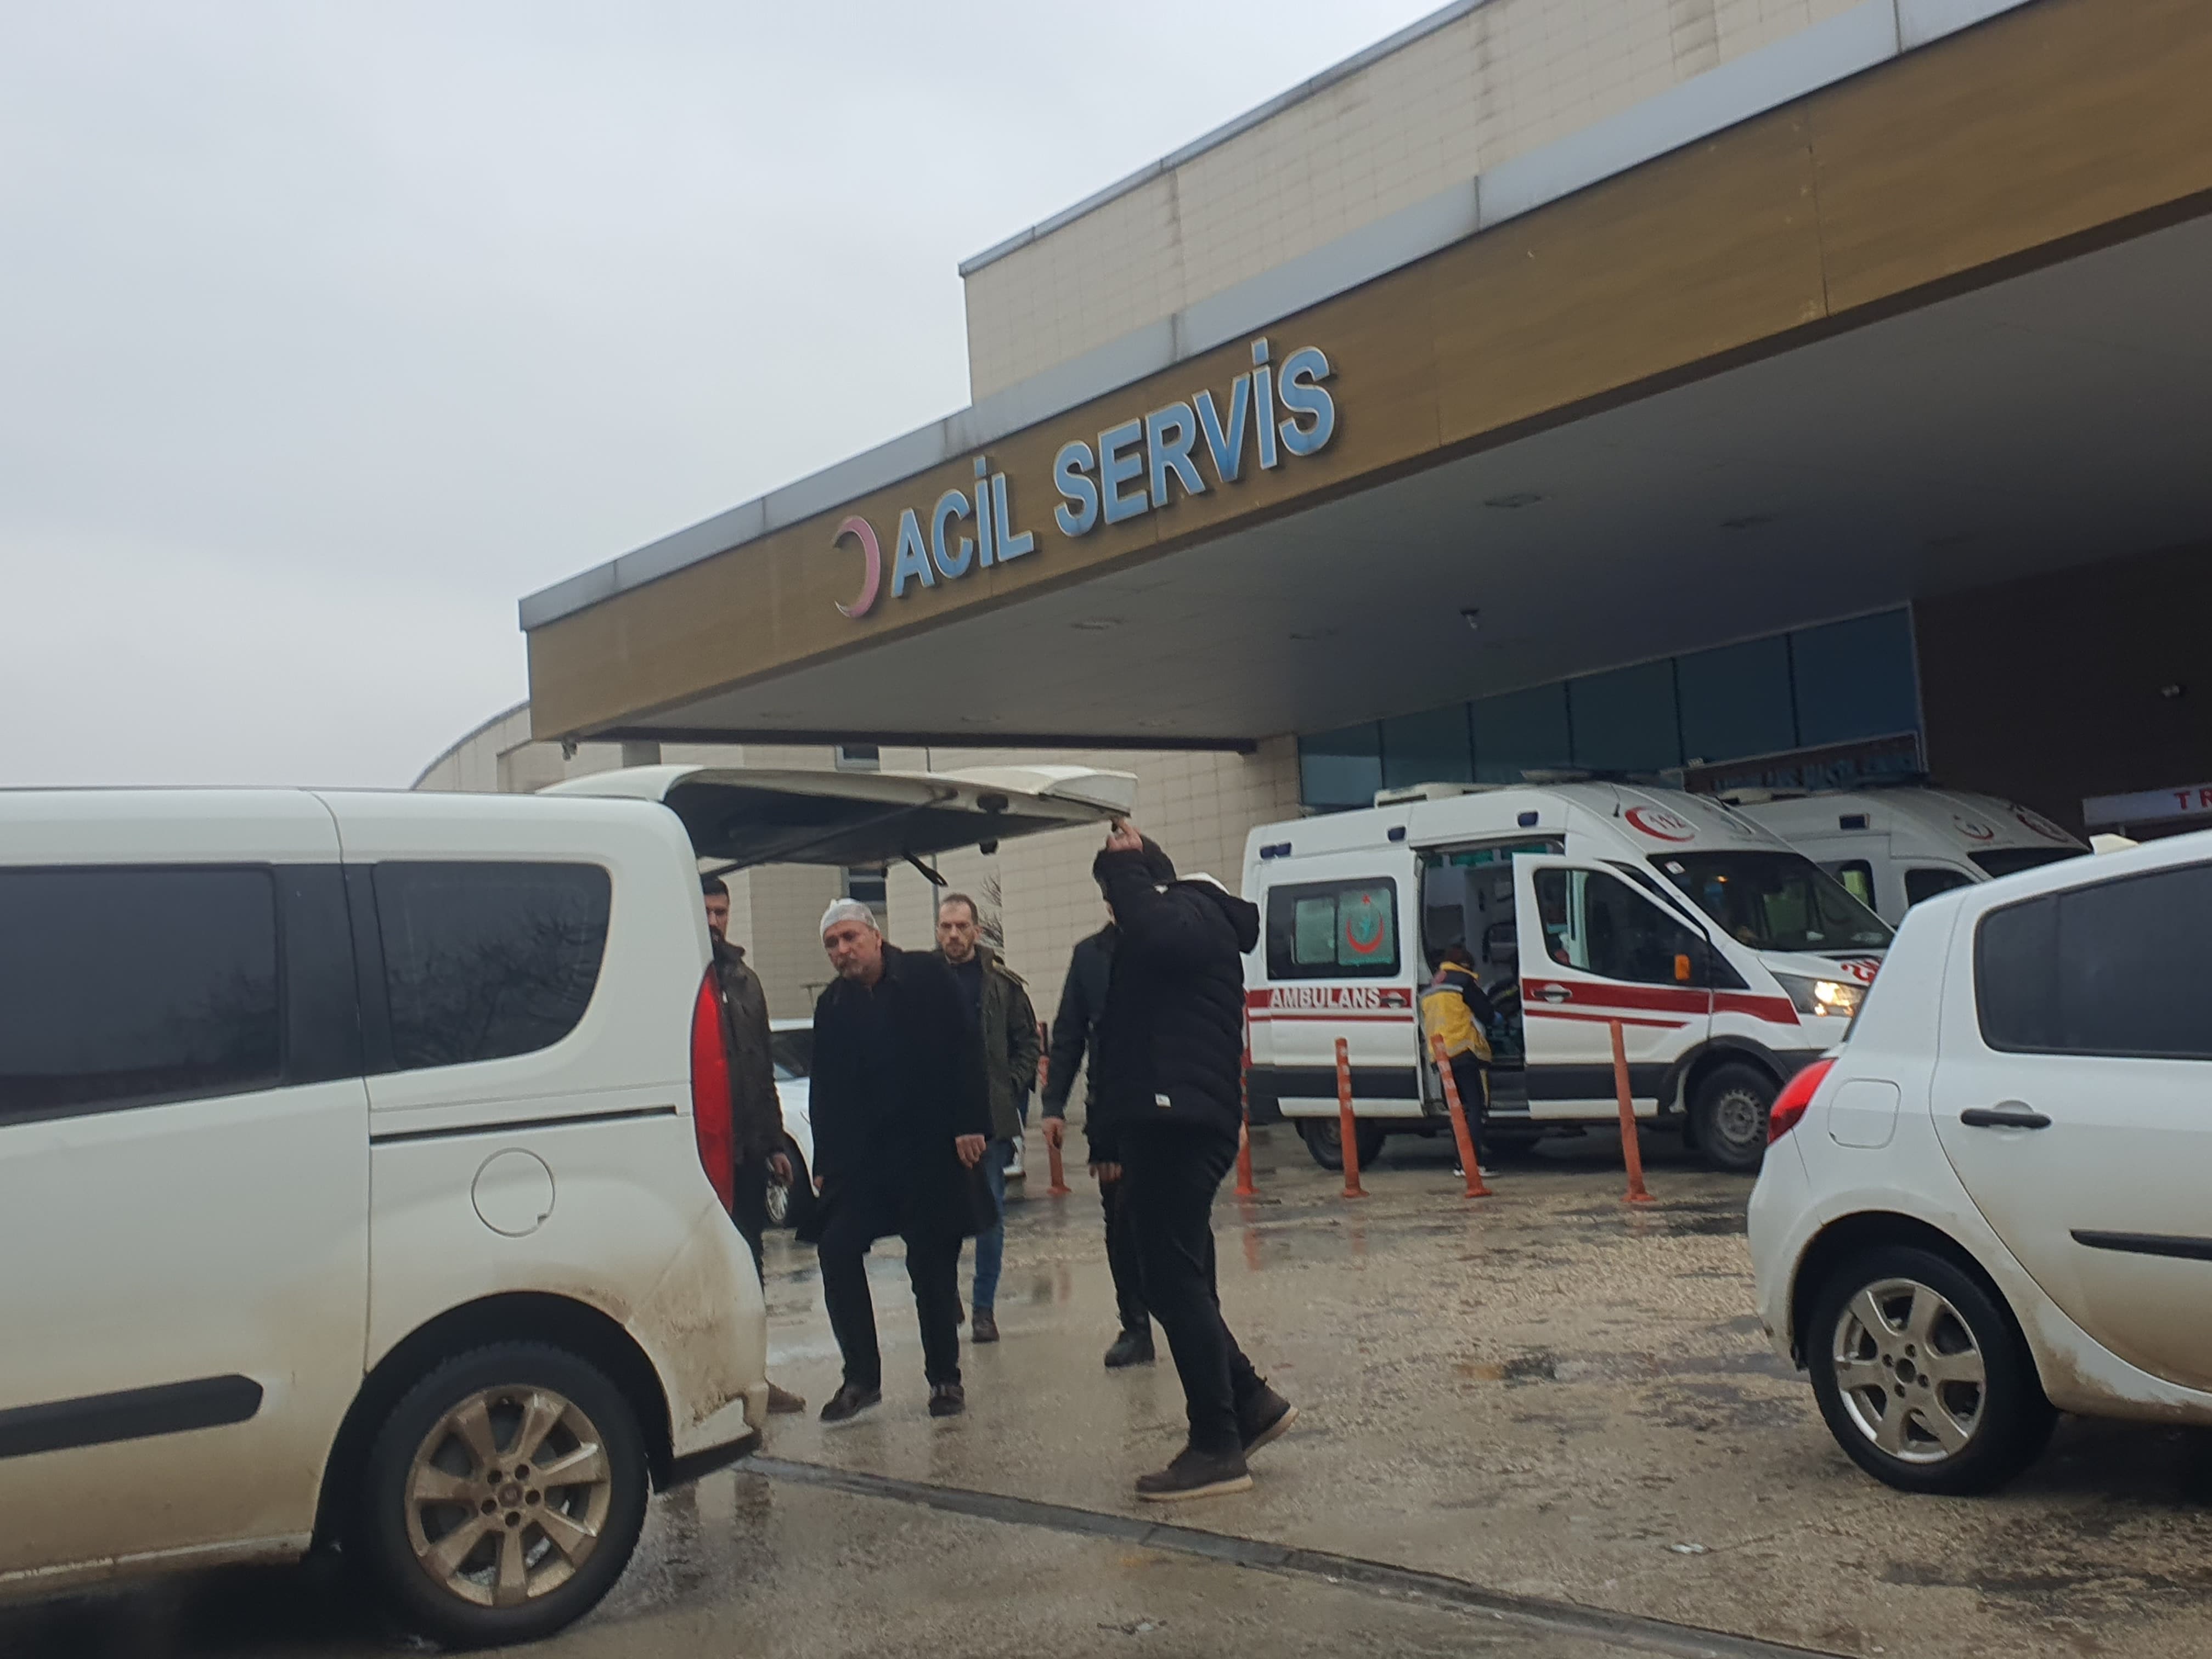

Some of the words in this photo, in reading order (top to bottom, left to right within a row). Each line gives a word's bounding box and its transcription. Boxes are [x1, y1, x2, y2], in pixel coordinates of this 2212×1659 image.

[890, 455, 1034, 597] ACİL
[1053, 337, 1335, 537] SERVİS
[1648, 813, 1686, 830] 112
[1271, 988, 1381, 1009] AMBULANS
